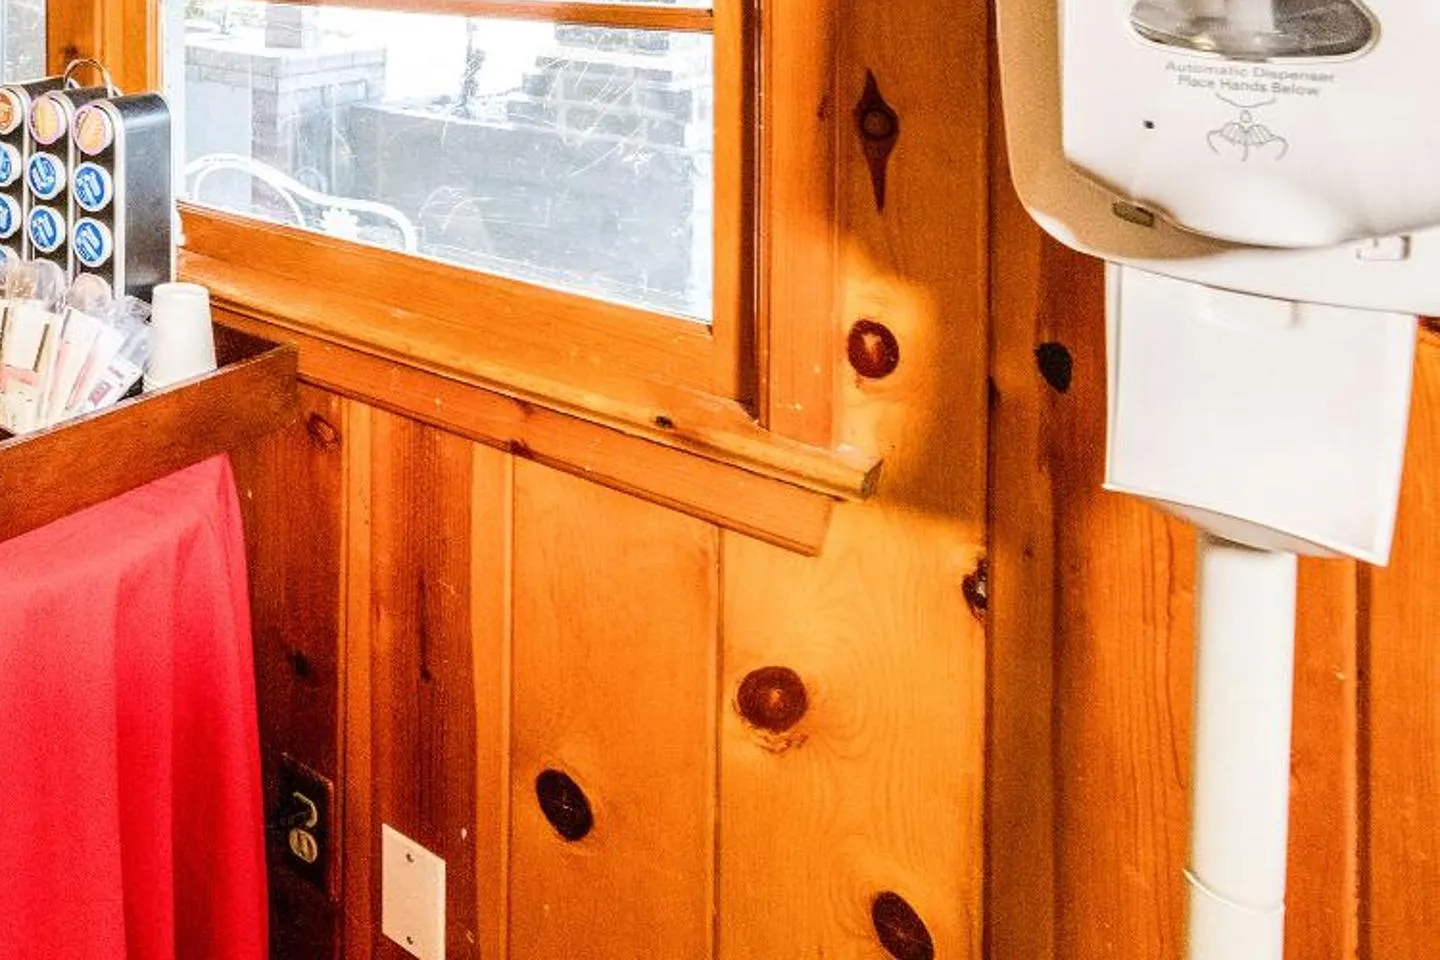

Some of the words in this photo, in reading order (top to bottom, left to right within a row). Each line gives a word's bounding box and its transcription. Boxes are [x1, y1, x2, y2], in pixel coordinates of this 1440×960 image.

[1165, 60, 1248, 77] Automatic
[1253, 66, 1335, 82] Dispenser
[1178, 73, 1215, 89] Place
[1220, 78, 1267, 92] Hands
